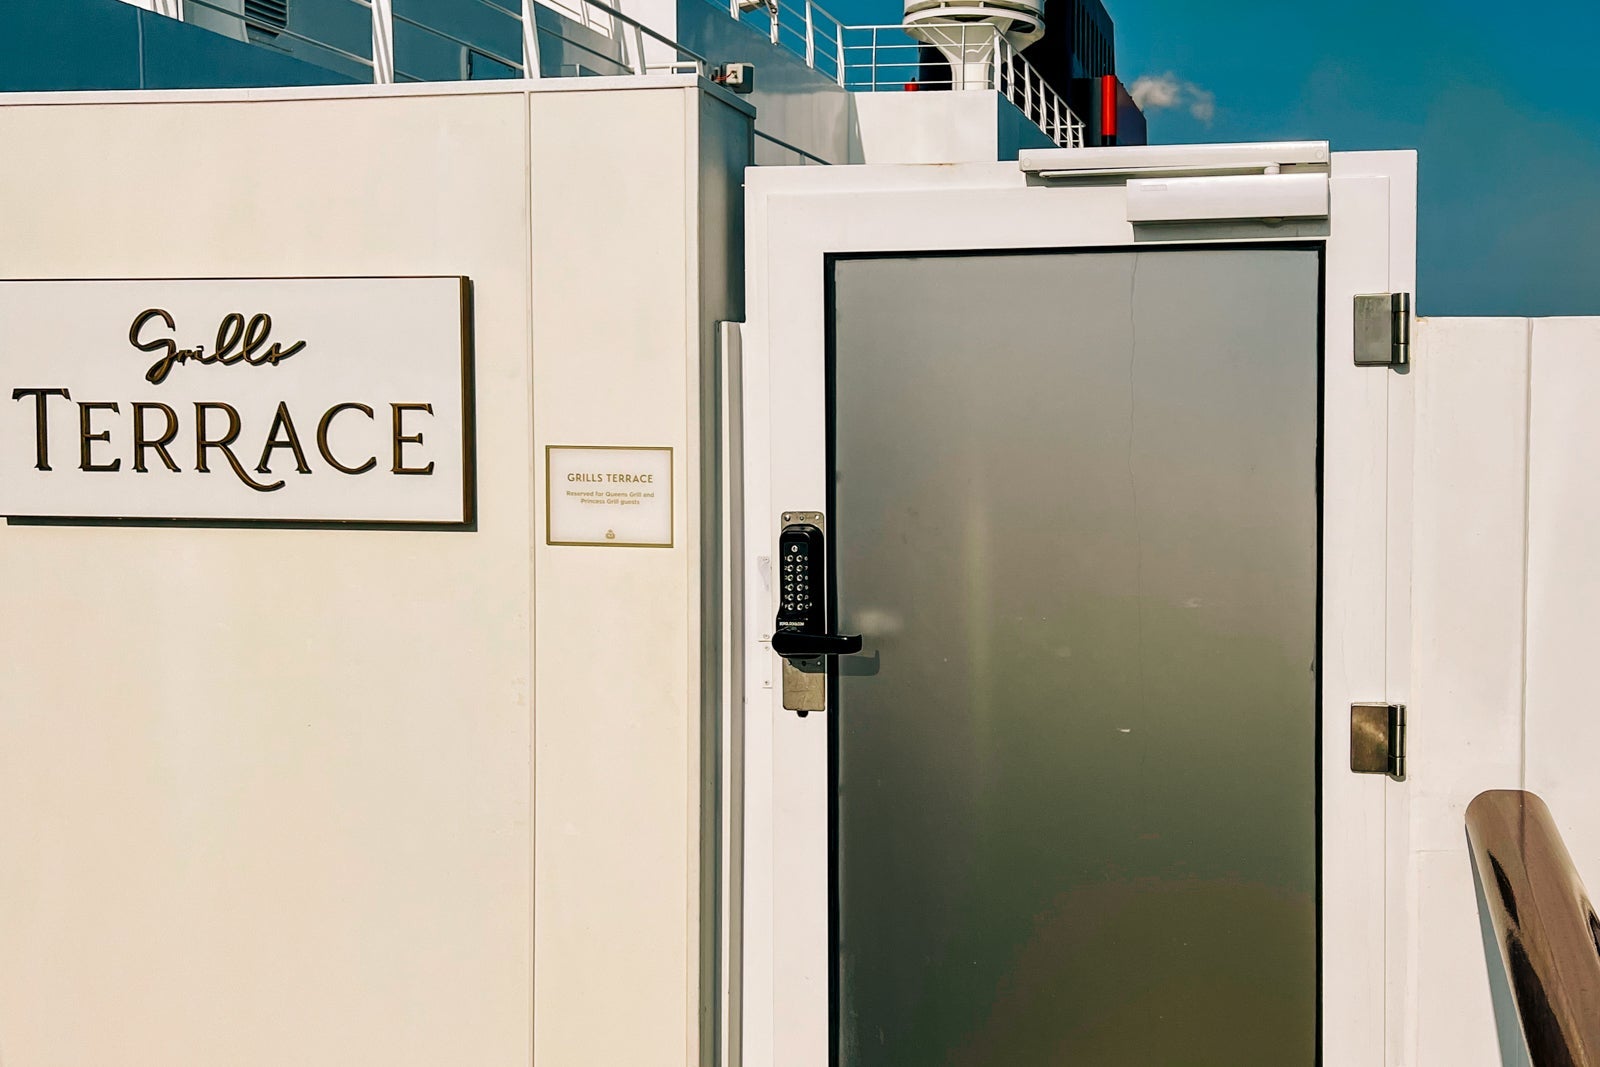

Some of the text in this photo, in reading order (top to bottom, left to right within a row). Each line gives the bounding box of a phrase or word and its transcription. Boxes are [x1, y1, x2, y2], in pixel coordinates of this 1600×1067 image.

[128, 308, 307, 385] Grills
[12, 388, 435, 493] TERRACE
[567, 473, 653, 484] GRILLS TERRACE
